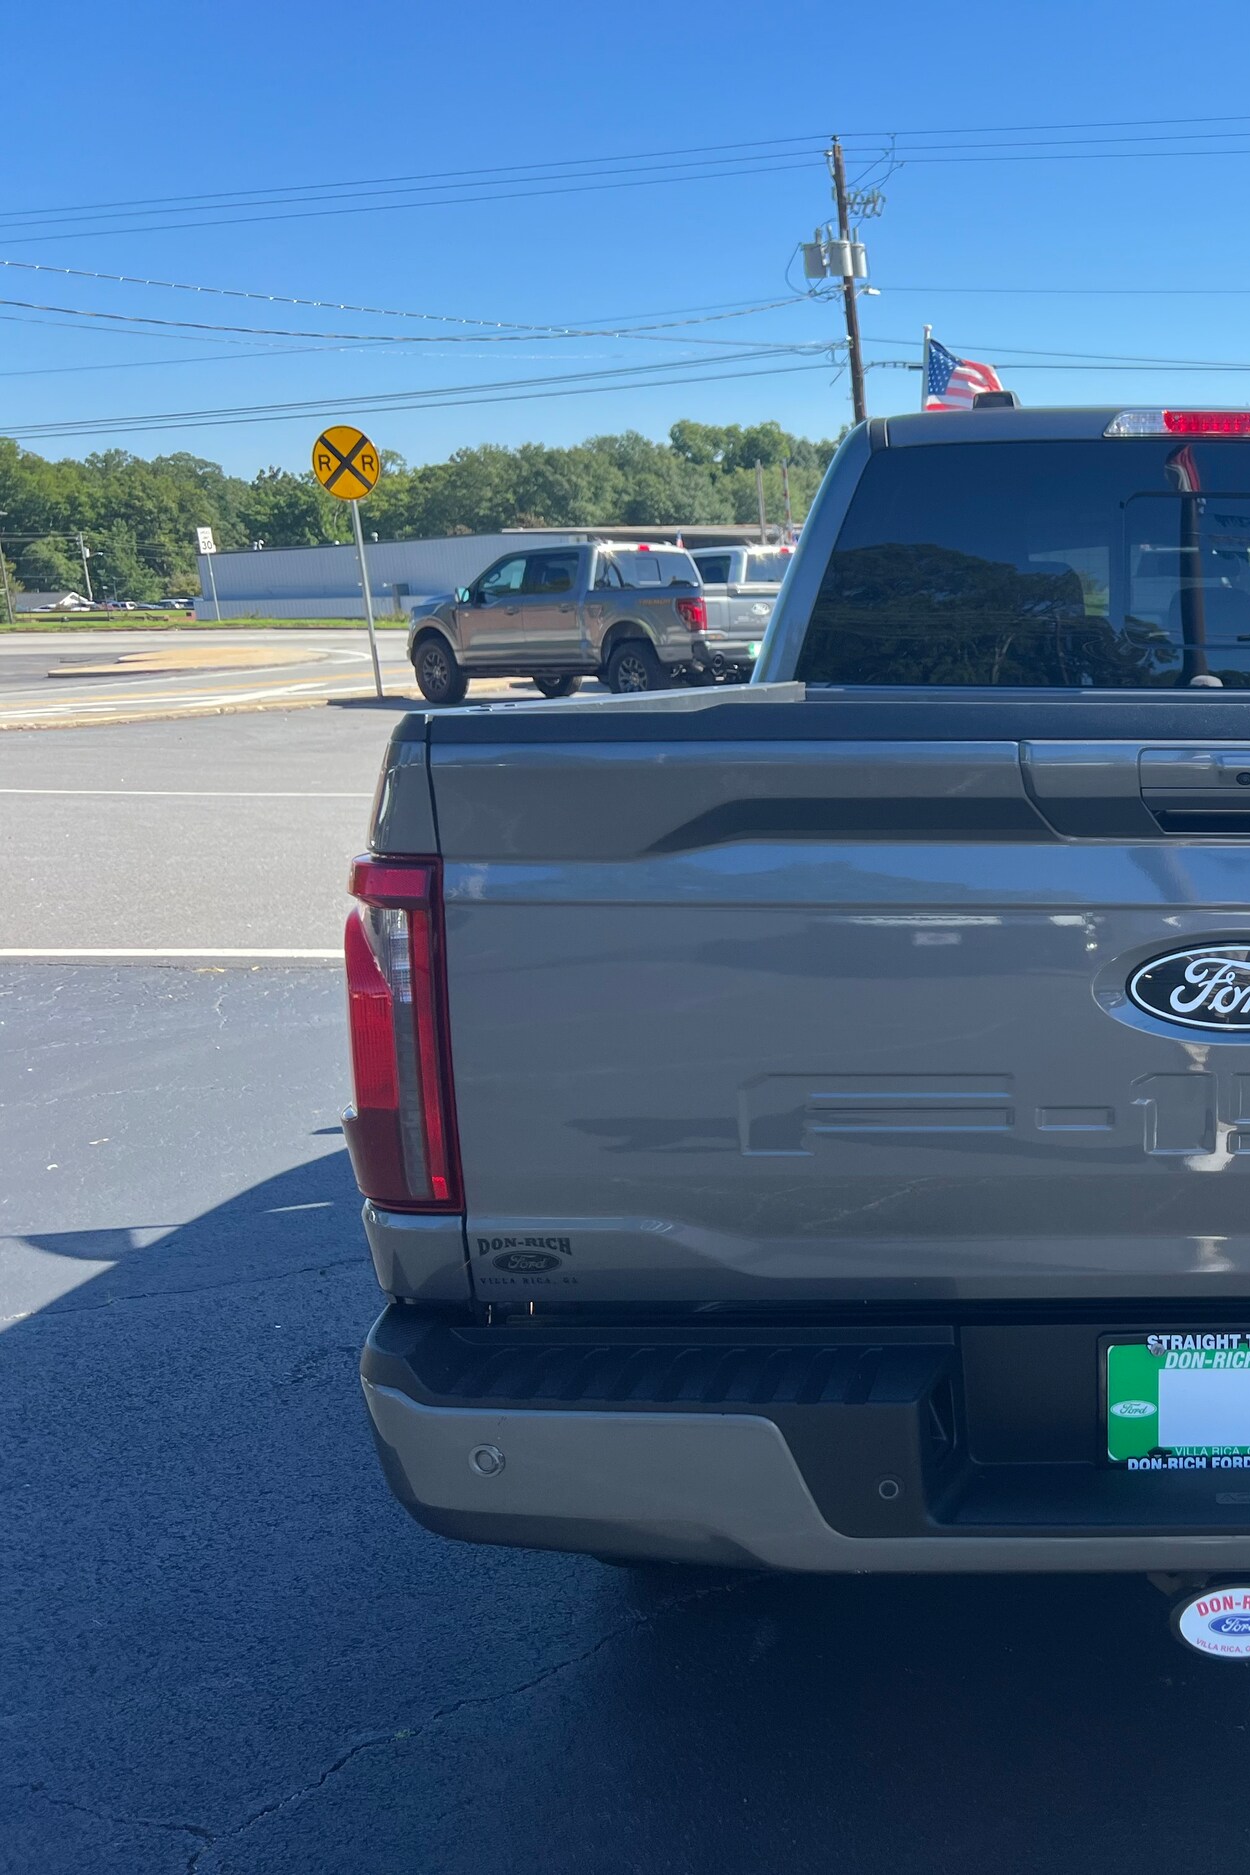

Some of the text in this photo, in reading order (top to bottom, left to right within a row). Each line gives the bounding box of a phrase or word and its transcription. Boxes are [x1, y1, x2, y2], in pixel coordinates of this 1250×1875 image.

[317, 454, 375, 472] R R
[201, 540, 213, 550] 30
[477, 1237, 572, 1256] DON-RICH
[507, 1254, 547, 1270] Ford
[480, 1277, 516, 1285] VILLA
[1147, 1334, 1241, 1351] STRAIGHT
[1119, 1402, 1149, 1415] Ford
[1175, 1446, 1209, 1457] VILLA
[1127, 1457, 1207, 1471] DON-RICH
[1195, 1637, 1219, 1652] VILLA
